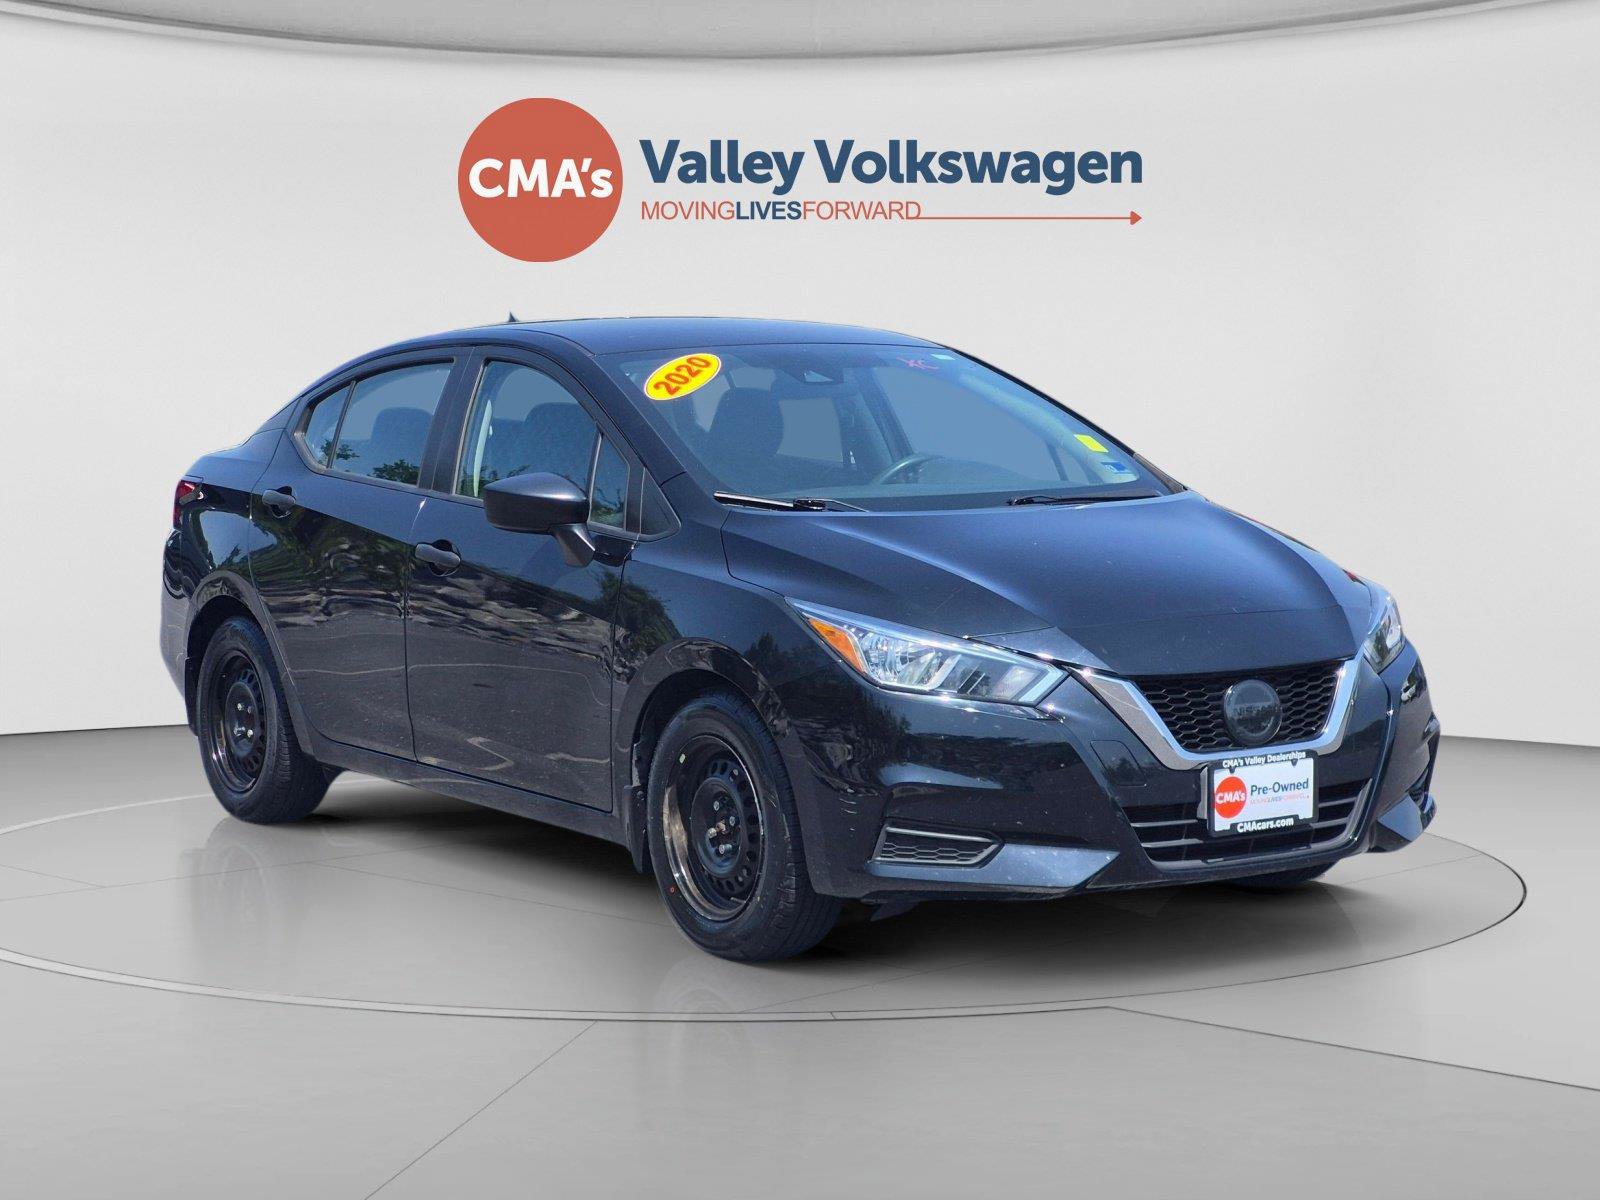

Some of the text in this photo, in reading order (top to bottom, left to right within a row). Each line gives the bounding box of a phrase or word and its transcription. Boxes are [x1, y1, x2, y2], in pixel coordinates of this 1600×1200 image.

[653, 357, 711, 395] 2020
[1222, 751, 1306, 768] CMA's Valley Dealerships
[1250, 778, 1308, 796] Pre-Owned
[1216, 791, 1246, 804] CMA's
[1237, 817, 1294, 832] CMAcars.com
